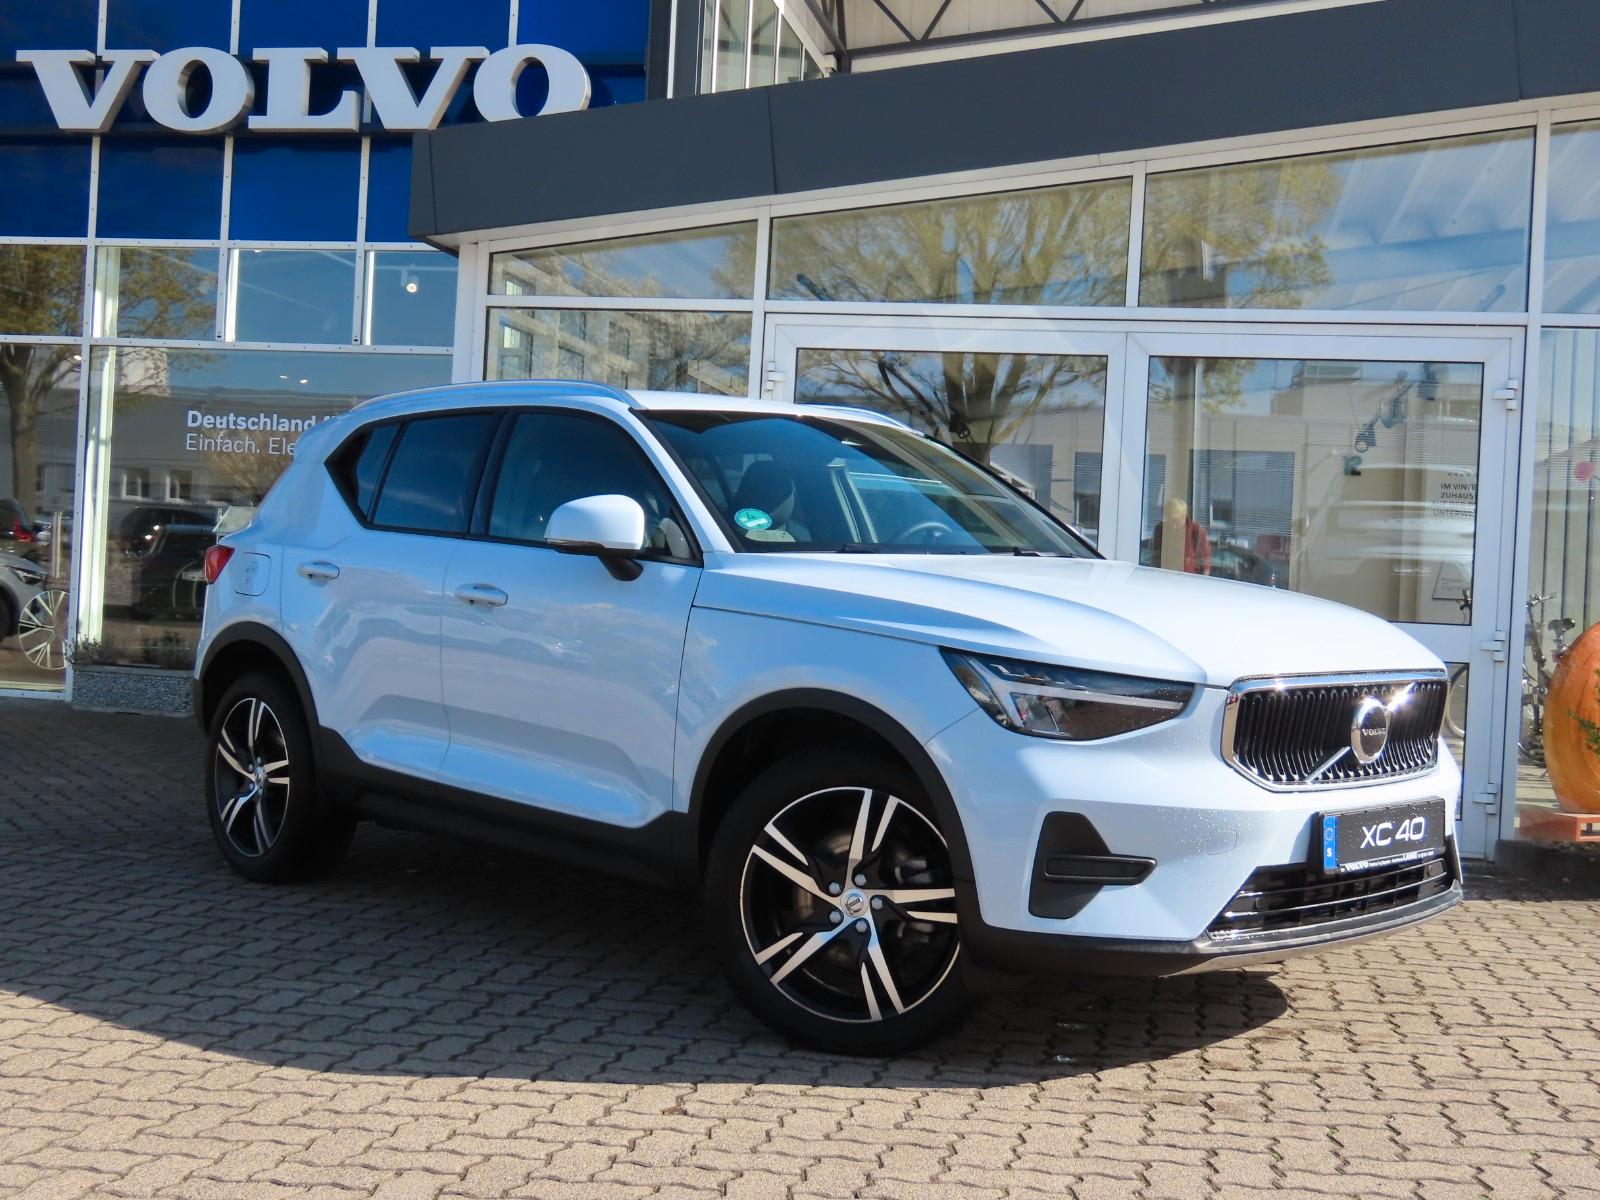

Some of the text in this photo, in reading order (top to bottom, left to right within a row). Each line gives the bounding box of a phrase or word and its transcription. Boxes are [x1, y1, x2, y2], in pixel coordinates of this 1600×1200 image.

[16, 43, 591, 132] VOLVO
[187, 410, 316, 432] Deutschland
[186, 433, 260, 454] Einfach.
